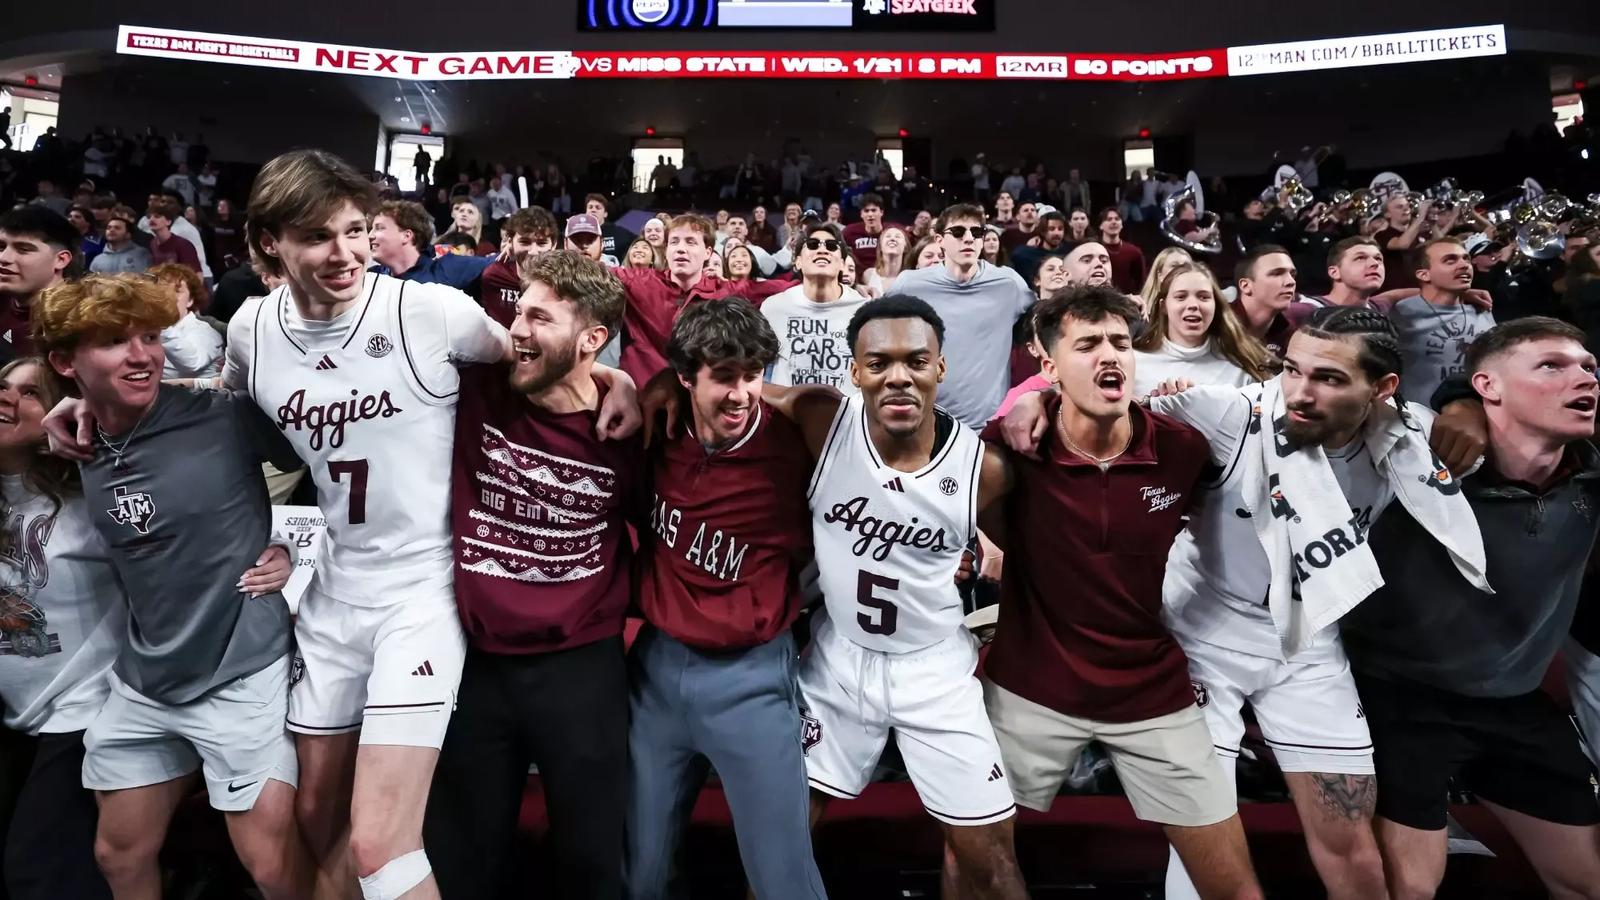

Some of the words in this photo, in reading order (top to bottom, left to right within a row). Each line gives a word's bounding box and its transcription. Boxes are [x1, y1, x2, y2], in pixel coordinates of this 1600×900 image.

[891, 0, 977, 15] SEATGEEK
[132, 35, 168, 49] TEXAS
[229, 44, 296, 60] BASKETBALL
[314, 47, 428, 75] NEXT
[438, 56, 555, 75] GAME
[581, 58, 612, 73] VS
[617, 57, 682, 72] MISS
[685, 57, 765, 72] STATE
[781, 58, 849, 73] WED.
[852, 58, 902, 73] 1/21
[940, 58, 982, 73] PM
[999, 60, 1063, 73] 12MR
[1074, 59, 1108, 75] 50
[1112, 55, 1214, 76] POINTS
[500, 288, 520, 302] TEX
[789, 319, 828, 335] RUN
[791, 337, 835, 356] CAR
[1425, 321, 1461, 356] TEXAS
[811, 354, 852, 370] NOT
[276, 389, 403, 451] Aggies
[327, 458, 369, 525] 7
[941, 480, 958, 494] SEC
[1139, 486, 1166, 501] Texas
[481, 488, 506, 512] GIG
[512, 498, 541, 520] 'EM
[1150, 492, 1182, 511] Aggies
[823, 496, 949, 562] Aggies
[685, 522, 749, 581] A&M
[857, 569, 900, 636] 5
